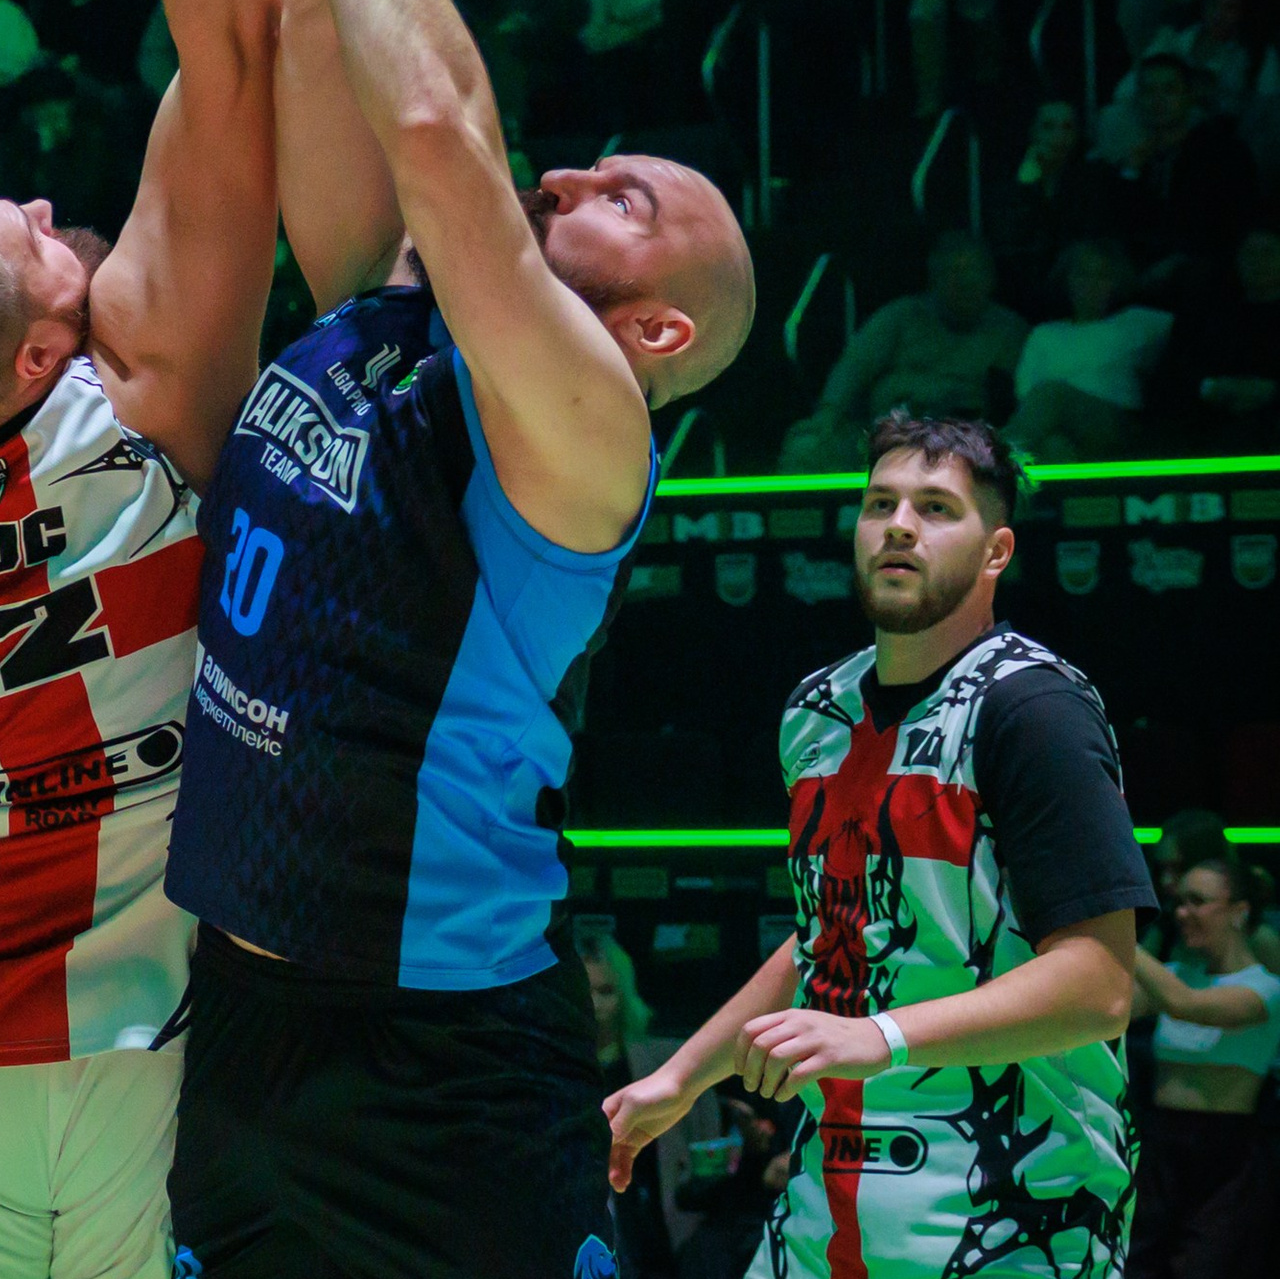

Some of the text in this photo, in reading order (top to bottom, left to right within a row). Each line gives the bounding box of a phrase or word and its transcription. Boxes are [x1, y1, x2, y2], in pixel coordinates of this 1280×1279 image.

[326, 361, 372, 416] LIGA PRO
[246, 381, 356, 496] ALIKSON
[260, 442, 302, 486] TEAM
[203, 654, 290, 735] аликсон
